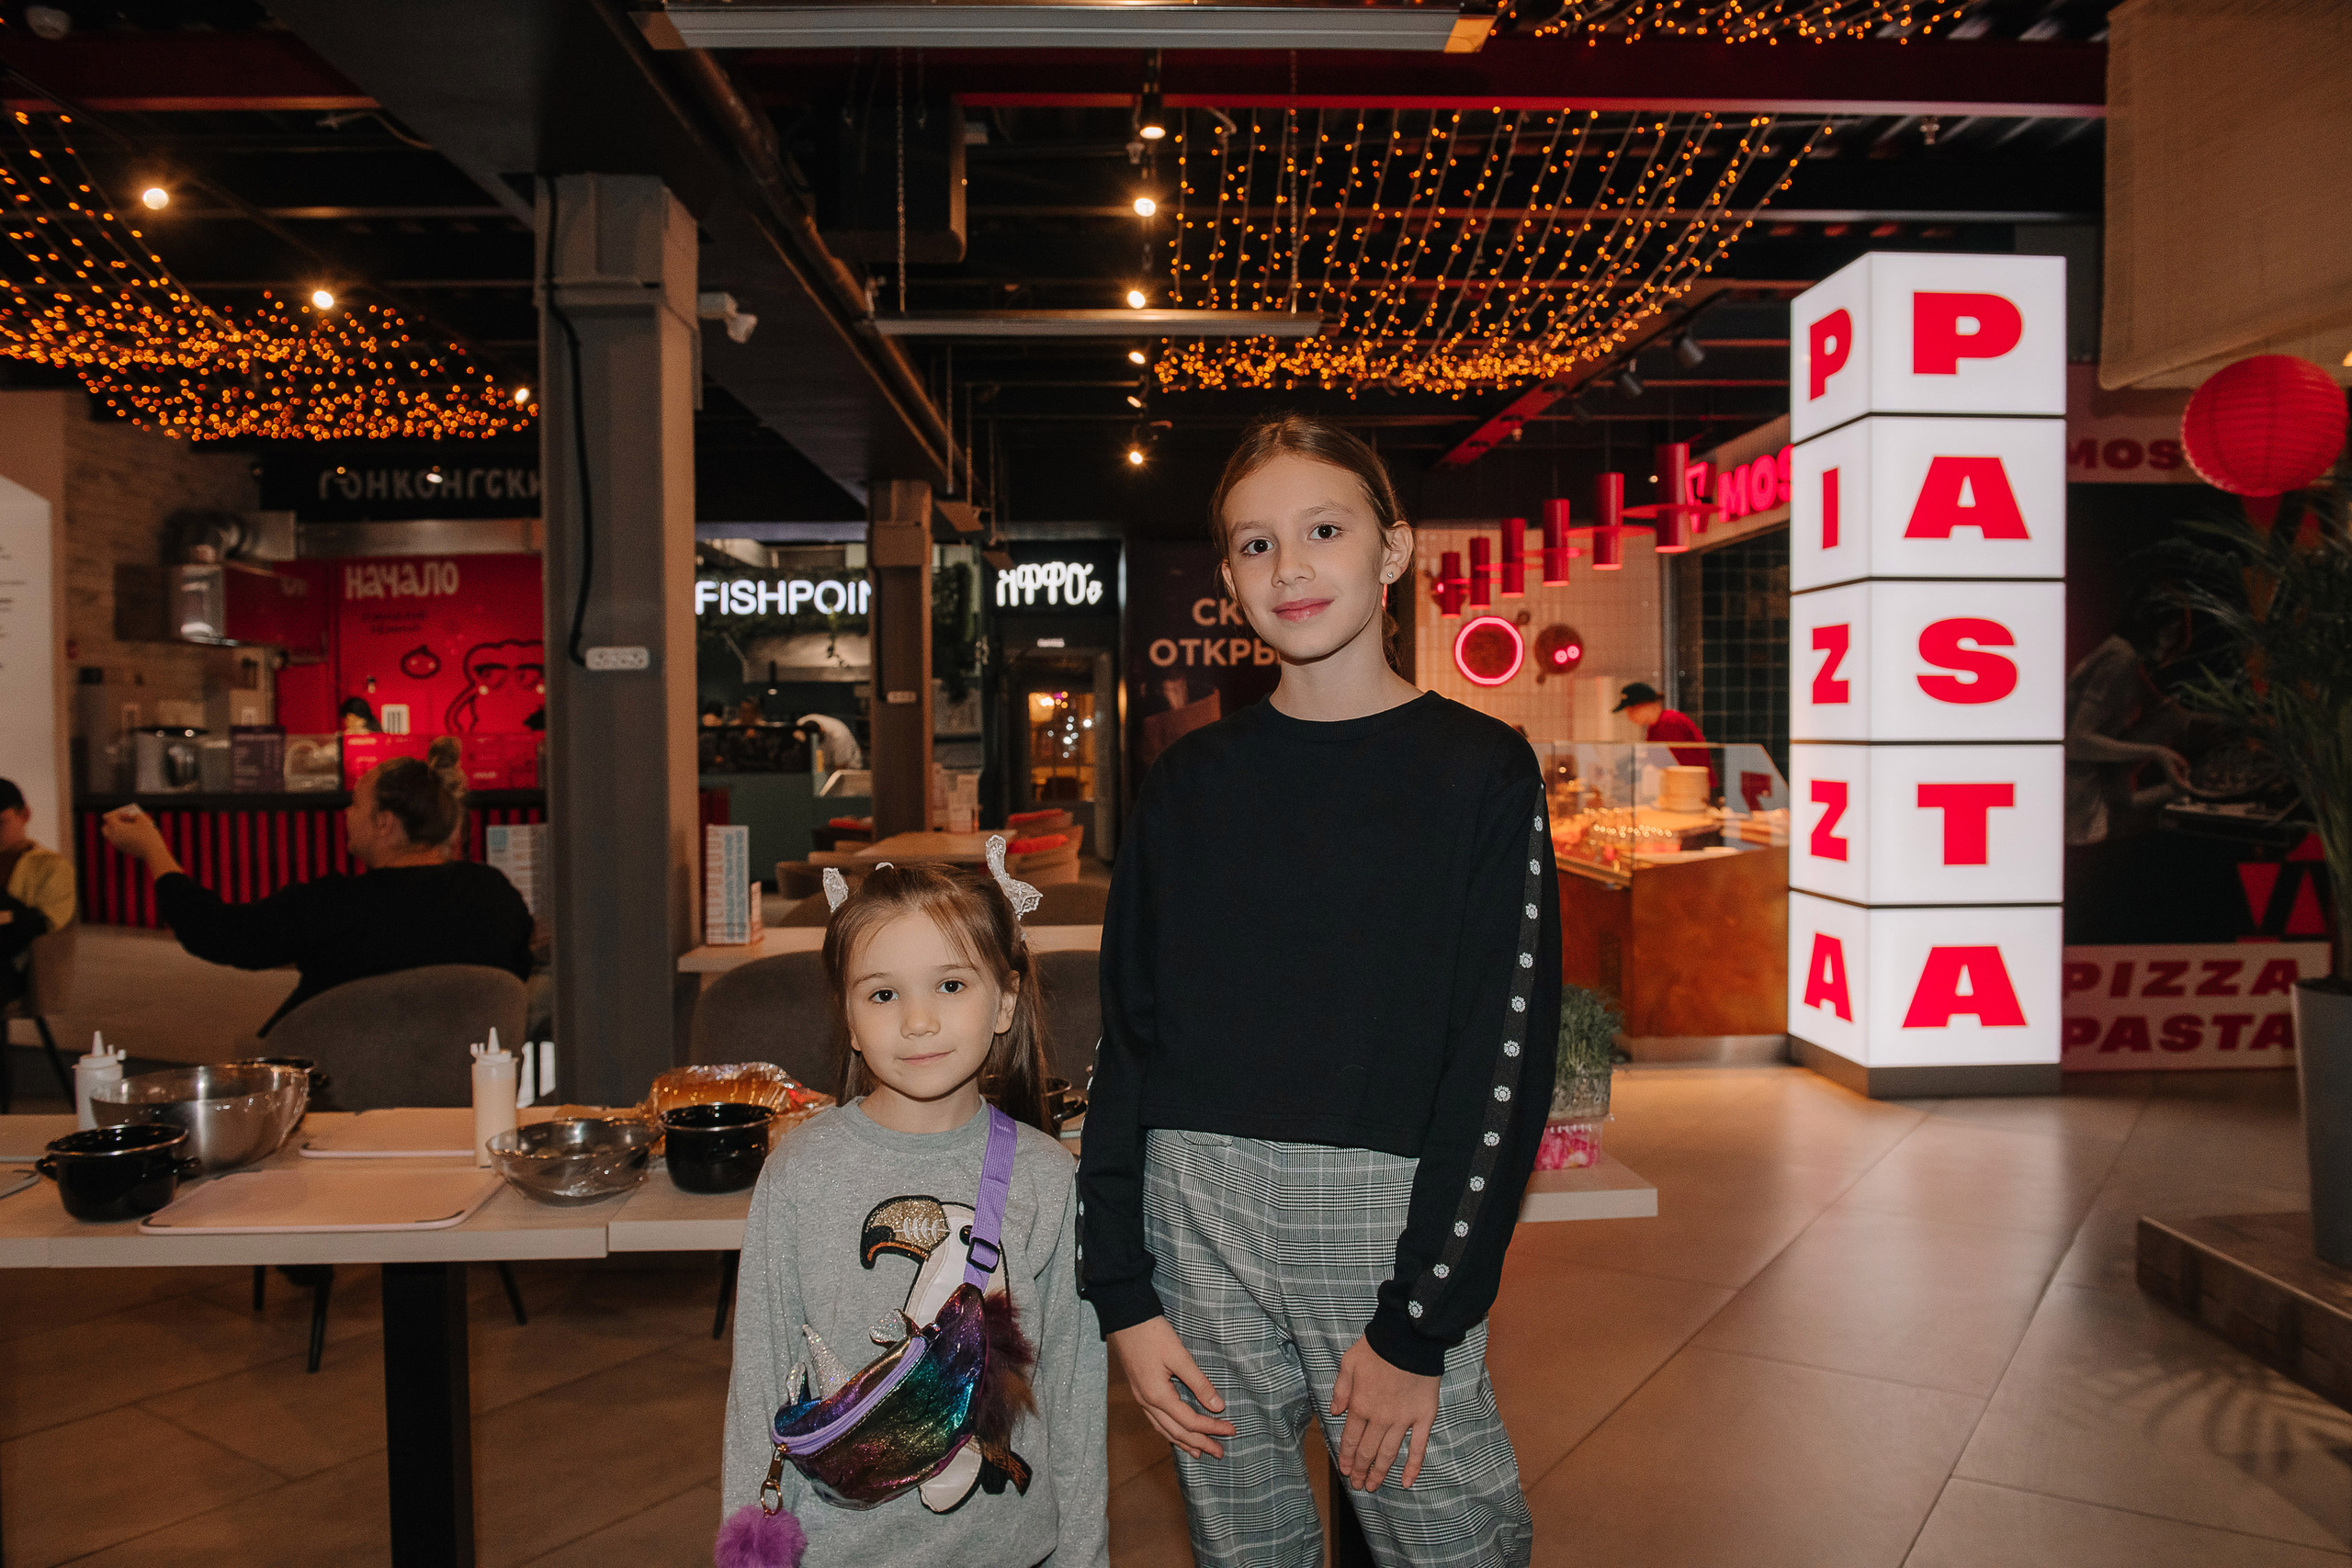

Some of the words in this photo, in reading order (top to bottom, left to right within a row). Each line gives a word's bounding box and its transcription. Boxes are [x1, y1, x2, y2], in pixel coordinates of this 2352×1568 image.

[1804, 309, 1853, 1022] PIZZA
[1903, 292, 2030, 1029] PASTA
[2064, 960, 2297, 998] PIZZA
[2064, 1014, 2294, 1053] PASTA
